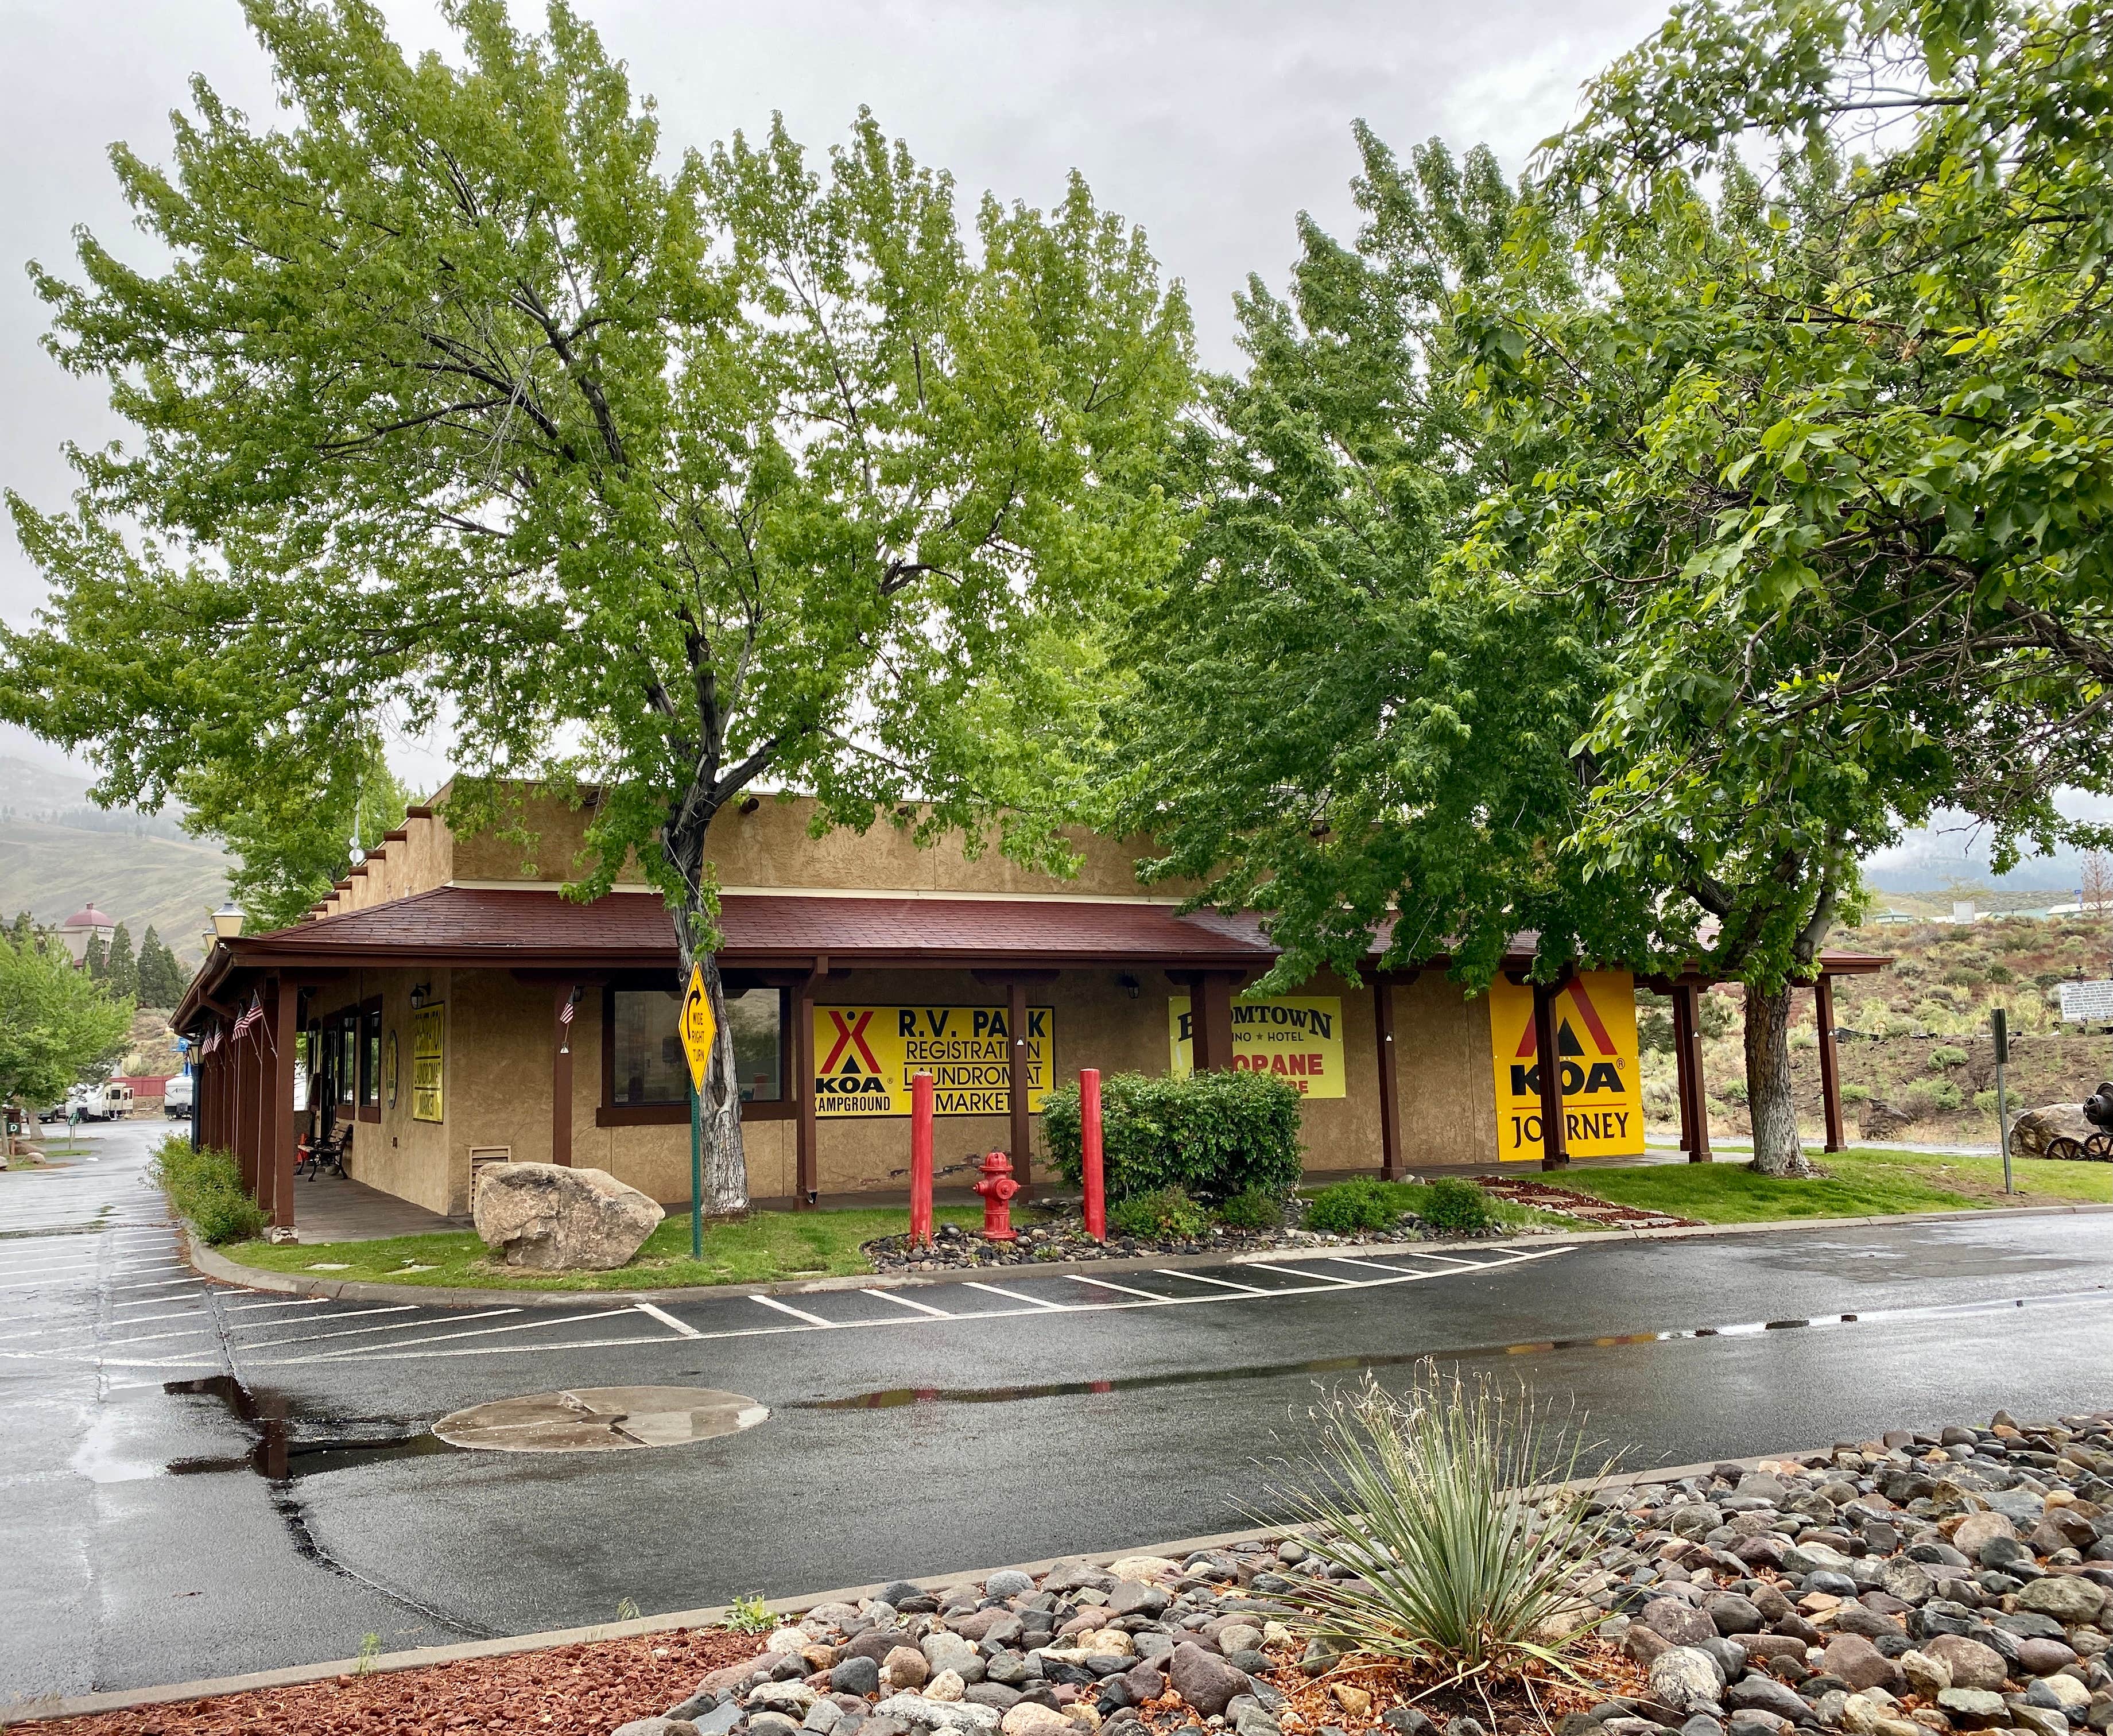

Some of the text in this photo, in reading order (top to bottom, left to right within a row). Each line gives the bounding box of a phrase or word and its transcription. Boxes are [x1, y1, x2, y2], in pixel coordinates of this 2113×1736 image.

[692, 1012, 703, 1025] WIDE
[899, 1009, 1046, 1037] R.V. PAK
[692, 1030, 704, 1044] RIGHT
[1267, 1032, 1304, 1042] HOTEL
[693, 1049, 704, 1062] TURN
[906, 1041, 1040, 1059] REGISTRATIN
[815, 1076, 886, 1094] KOA
[1510, 1061, 1626, 1096] KOA
[10, 1124, 17, 1132] D
[1511, 1112, 1629, 1148] JORNEY
